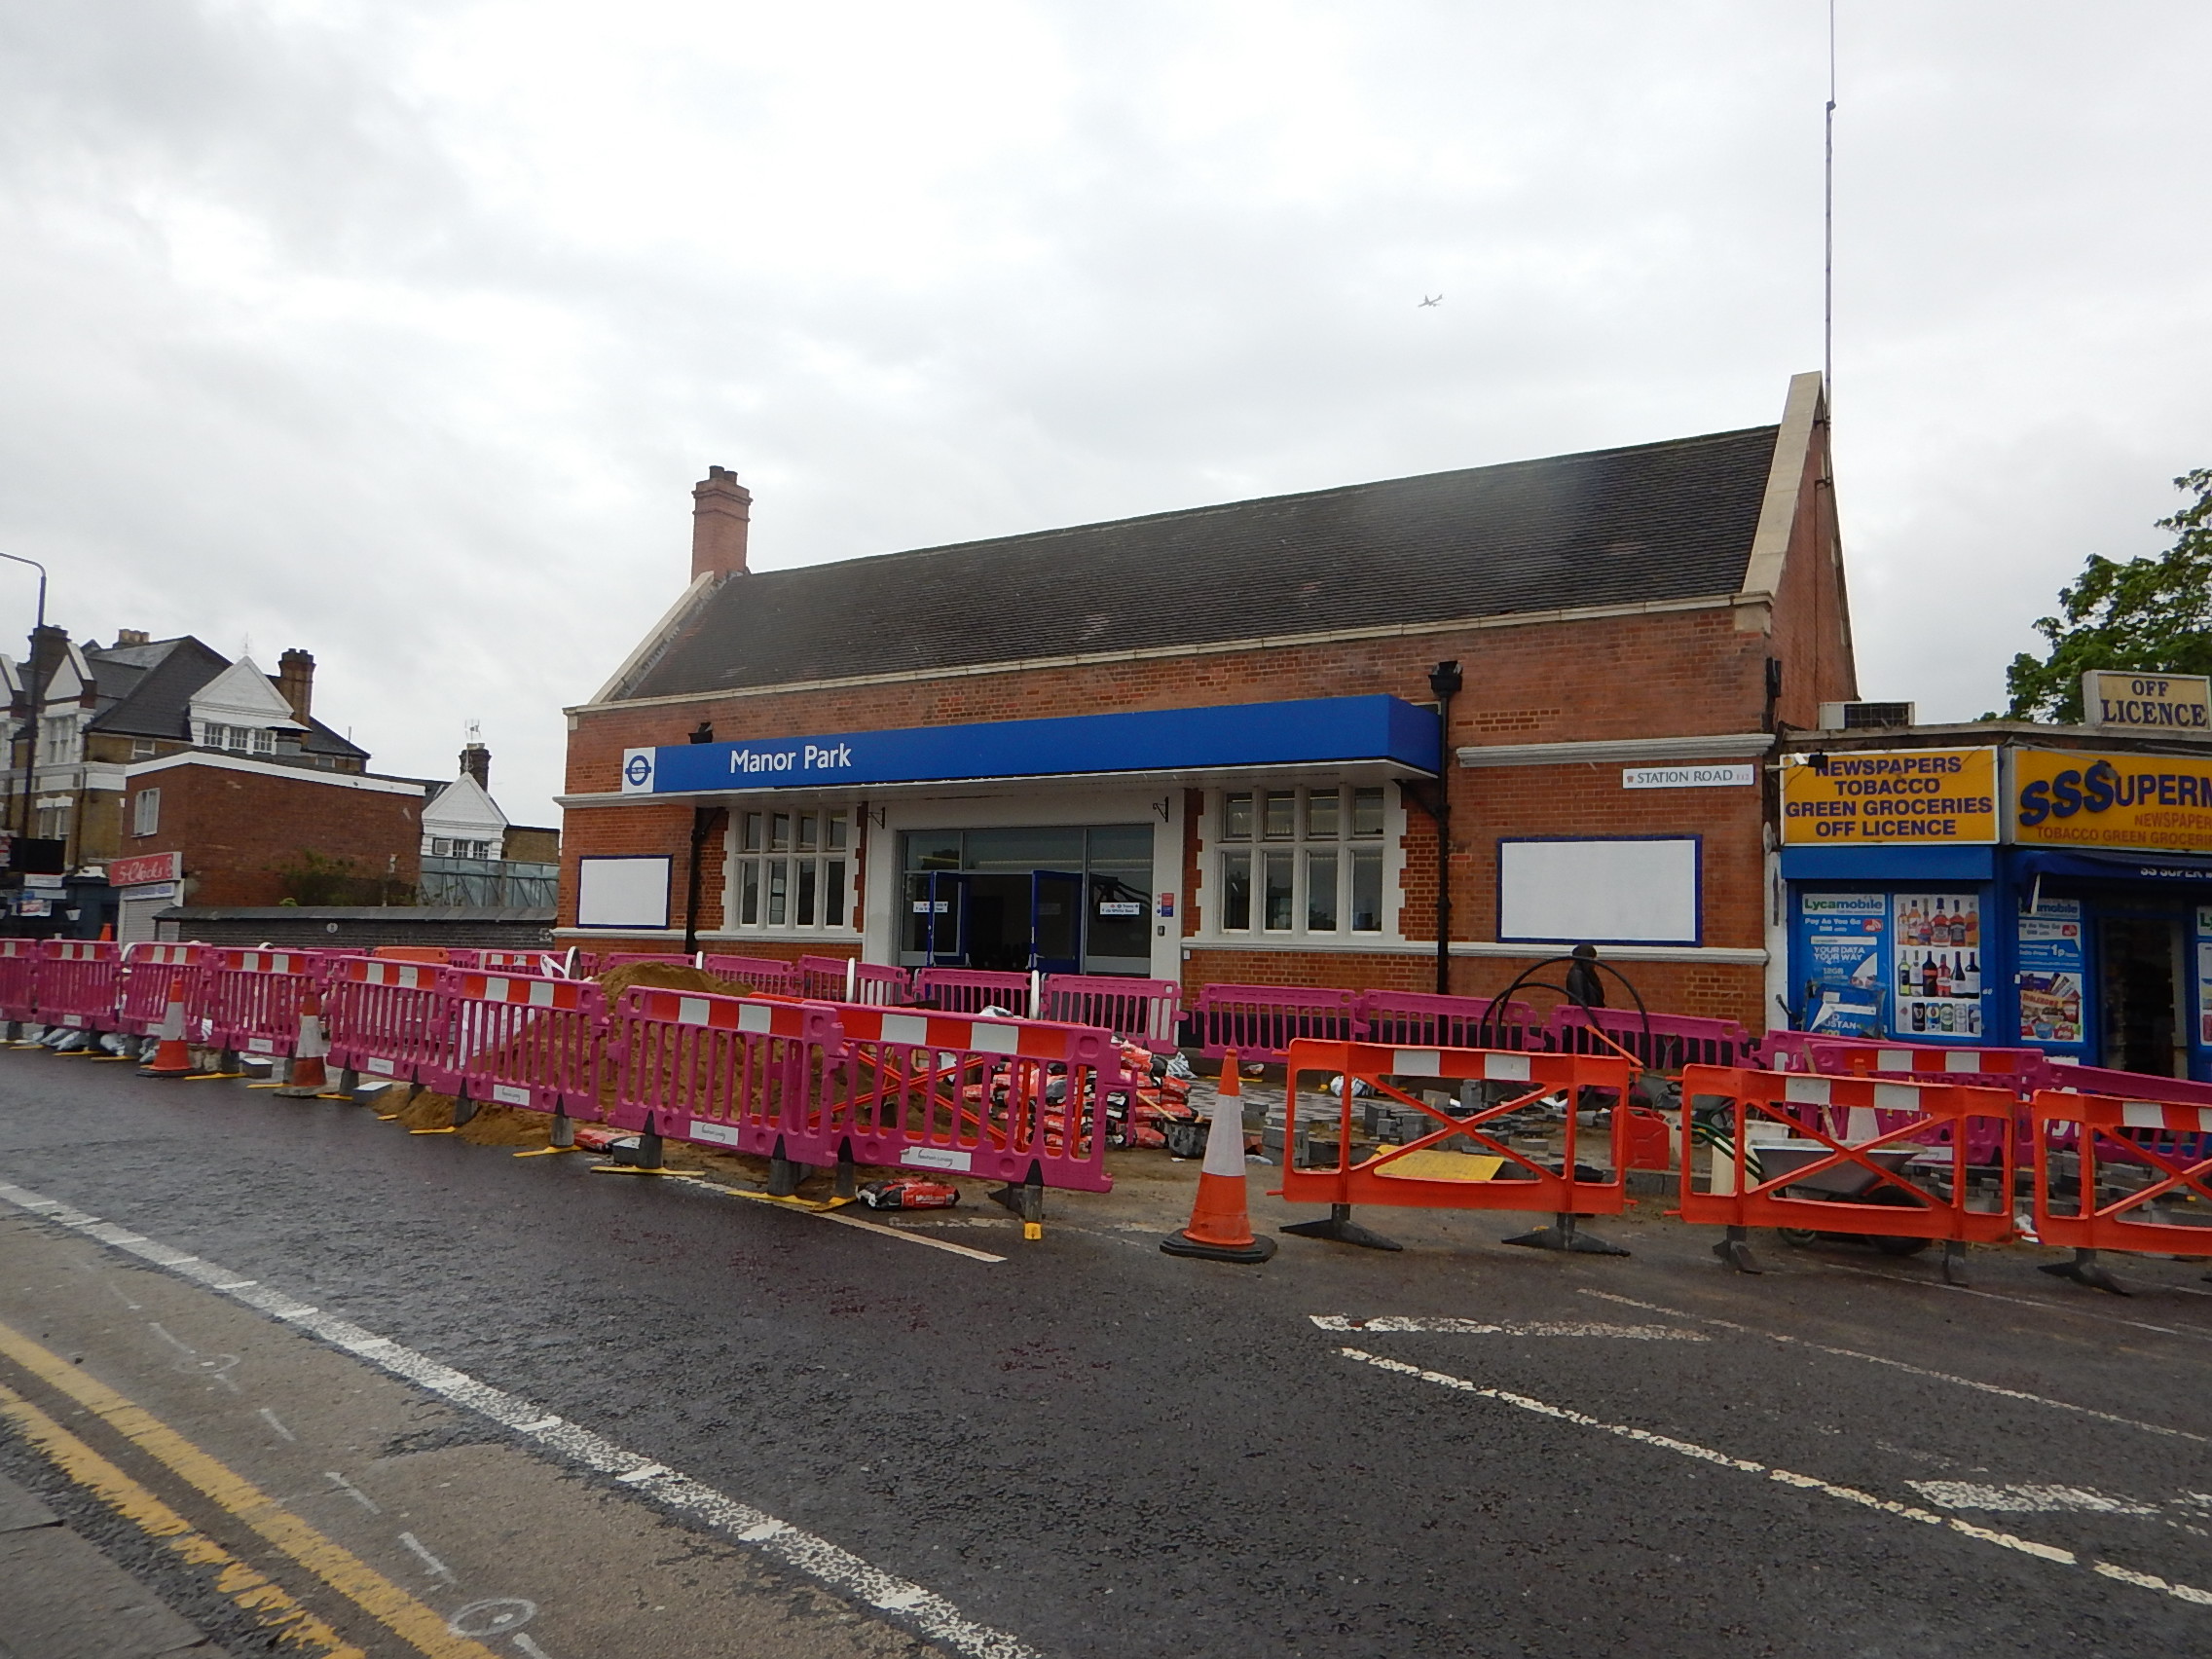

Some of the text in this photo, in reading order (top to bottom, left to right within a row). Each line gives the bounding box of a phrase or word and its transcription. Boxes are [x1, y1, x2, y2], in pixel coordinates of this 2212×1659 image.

[2131, 681, 2169, 696] OFF
[2101, 699, 2207, 727] LICENCE
[730, 743, 852, 773] Manor Park
[1815, 756, 1962, 777] NEWSPAPERS
[1638, 771, 1689, 784] STATION
[1694, 769, 1733, 782] ROAD
[1834, 778, 1940, 795] TOBACCO
[1786, 796, 1993, 817] GREEN GROCERIES
[1816, 819, 1957, 836] OFF LICENCE
[2036, 827, 2099, 840] TOBACCO
[2102, 830, 2147, 843] GREEN
[1804, 898, 1883, 910] Lycamobile
